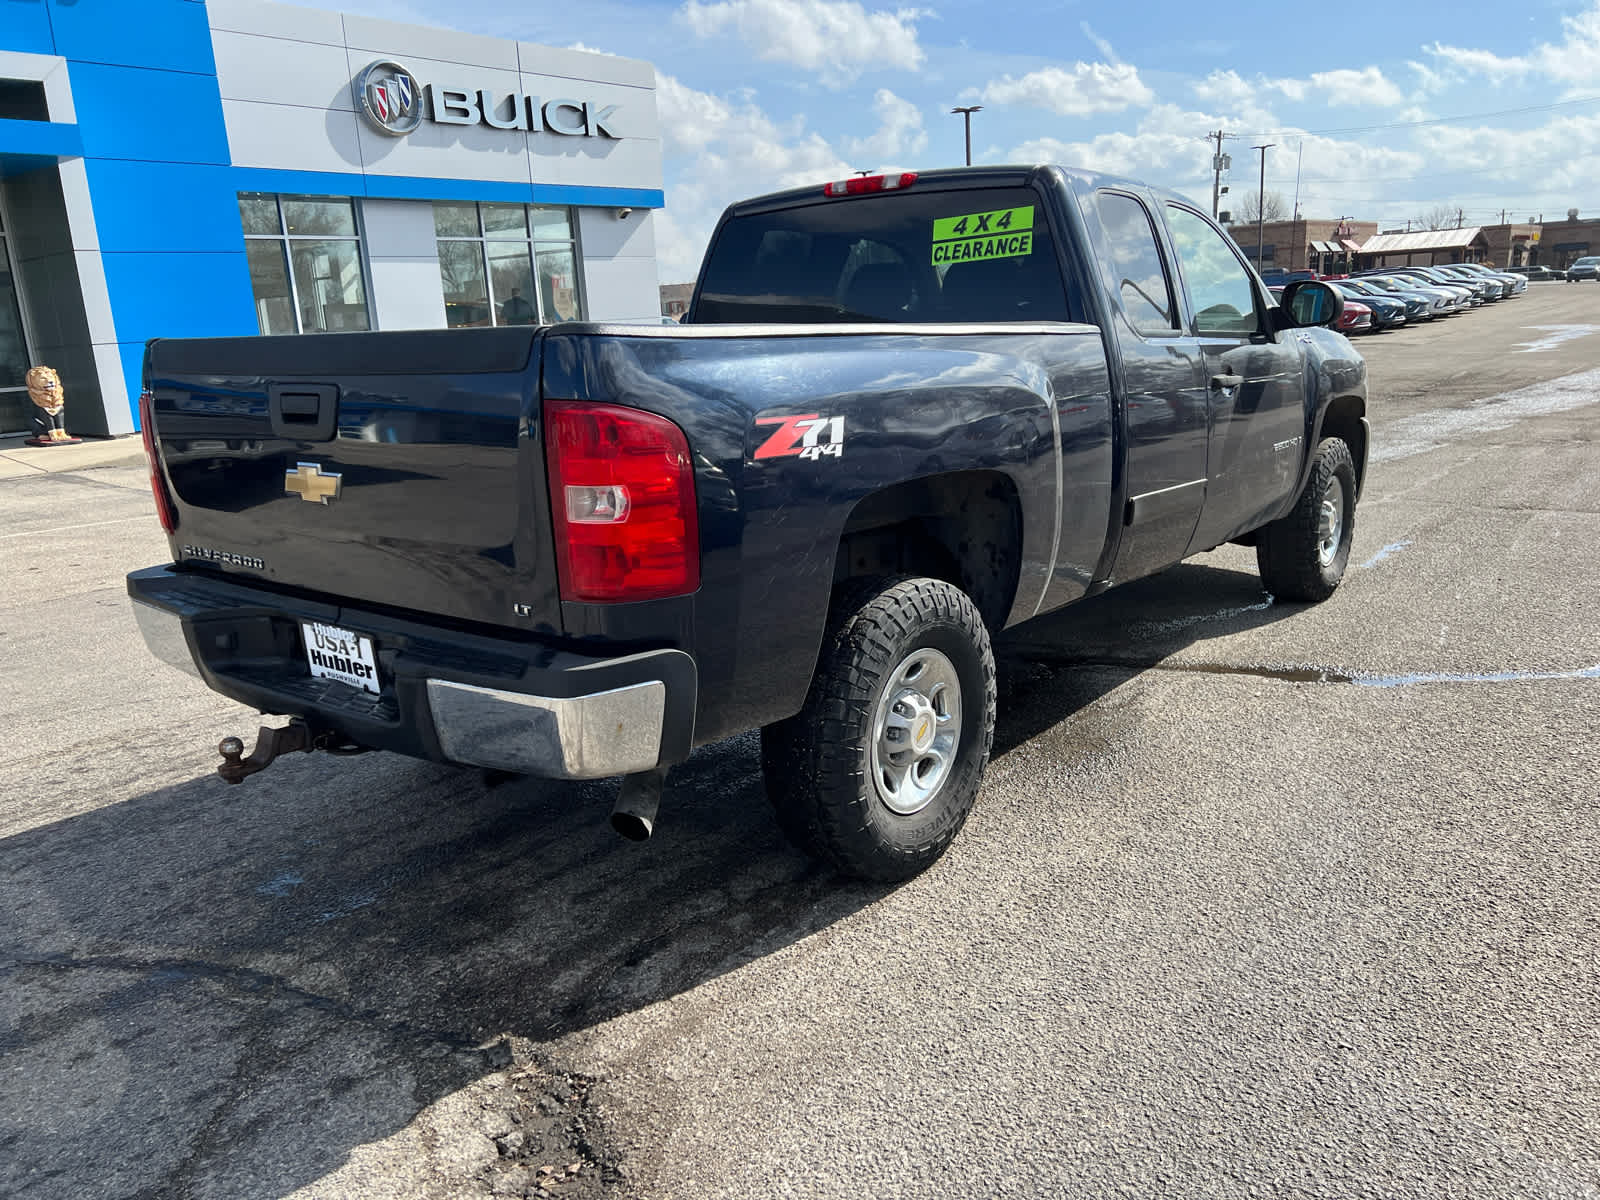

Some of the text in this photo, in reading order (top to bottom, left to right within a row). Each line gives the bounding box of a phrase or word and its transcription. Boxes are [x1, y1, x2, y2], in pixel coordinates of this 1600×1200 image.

[430, 84, 624, 139] BUICK
[934, 235, 1030, 262] CLEARANCE
[754, 413, 844, 459] Z71
[183, 544, 265, 569] SILVERADO
[513, 603, 532, 616] LT
[314, 632, 363, 660] USA-1
[310, 648, 373, 679] Hubler
